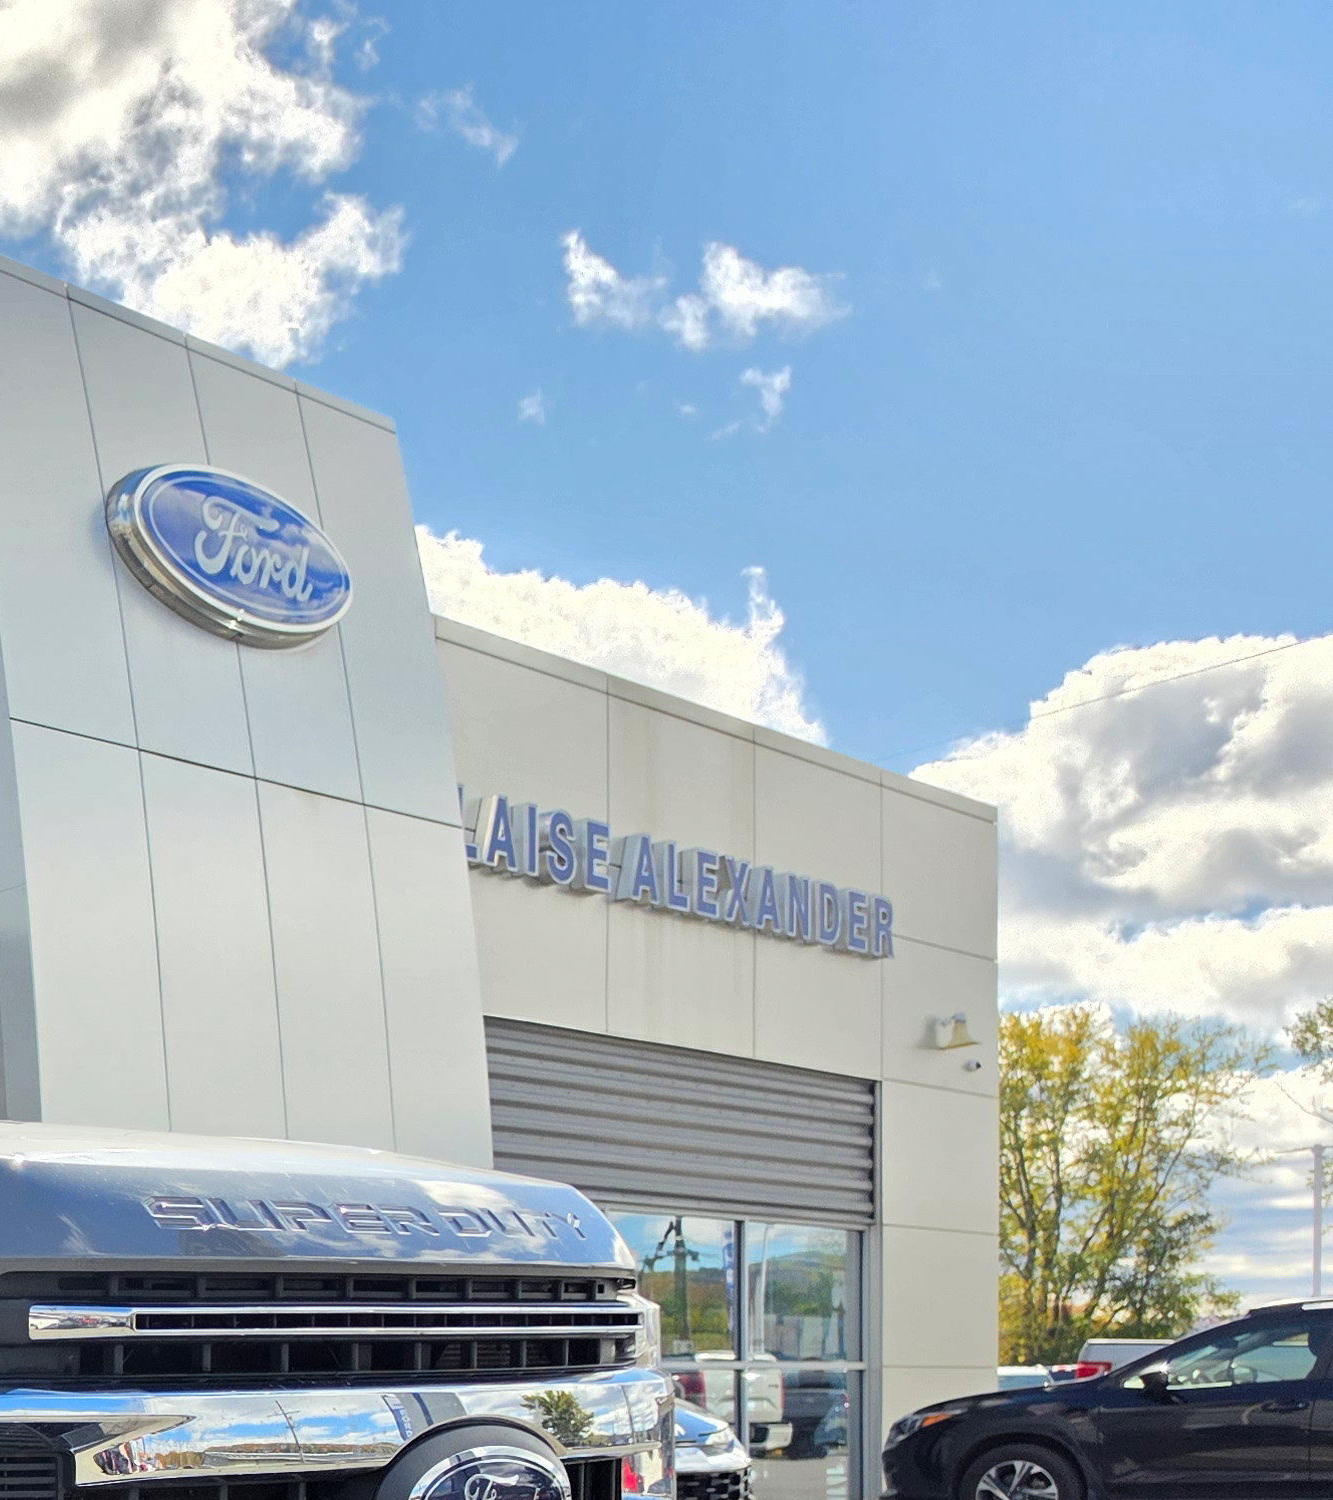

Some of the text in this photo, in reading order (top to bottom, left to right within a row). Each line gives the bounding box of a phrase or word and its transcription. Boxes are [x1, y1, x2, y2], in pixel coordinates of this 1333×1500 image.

[195, 496, 313, 601] Ford
[630, 833, 894, 958] ALEXANDER
[144, 1195, 587, 1240] SUPER DUTY
